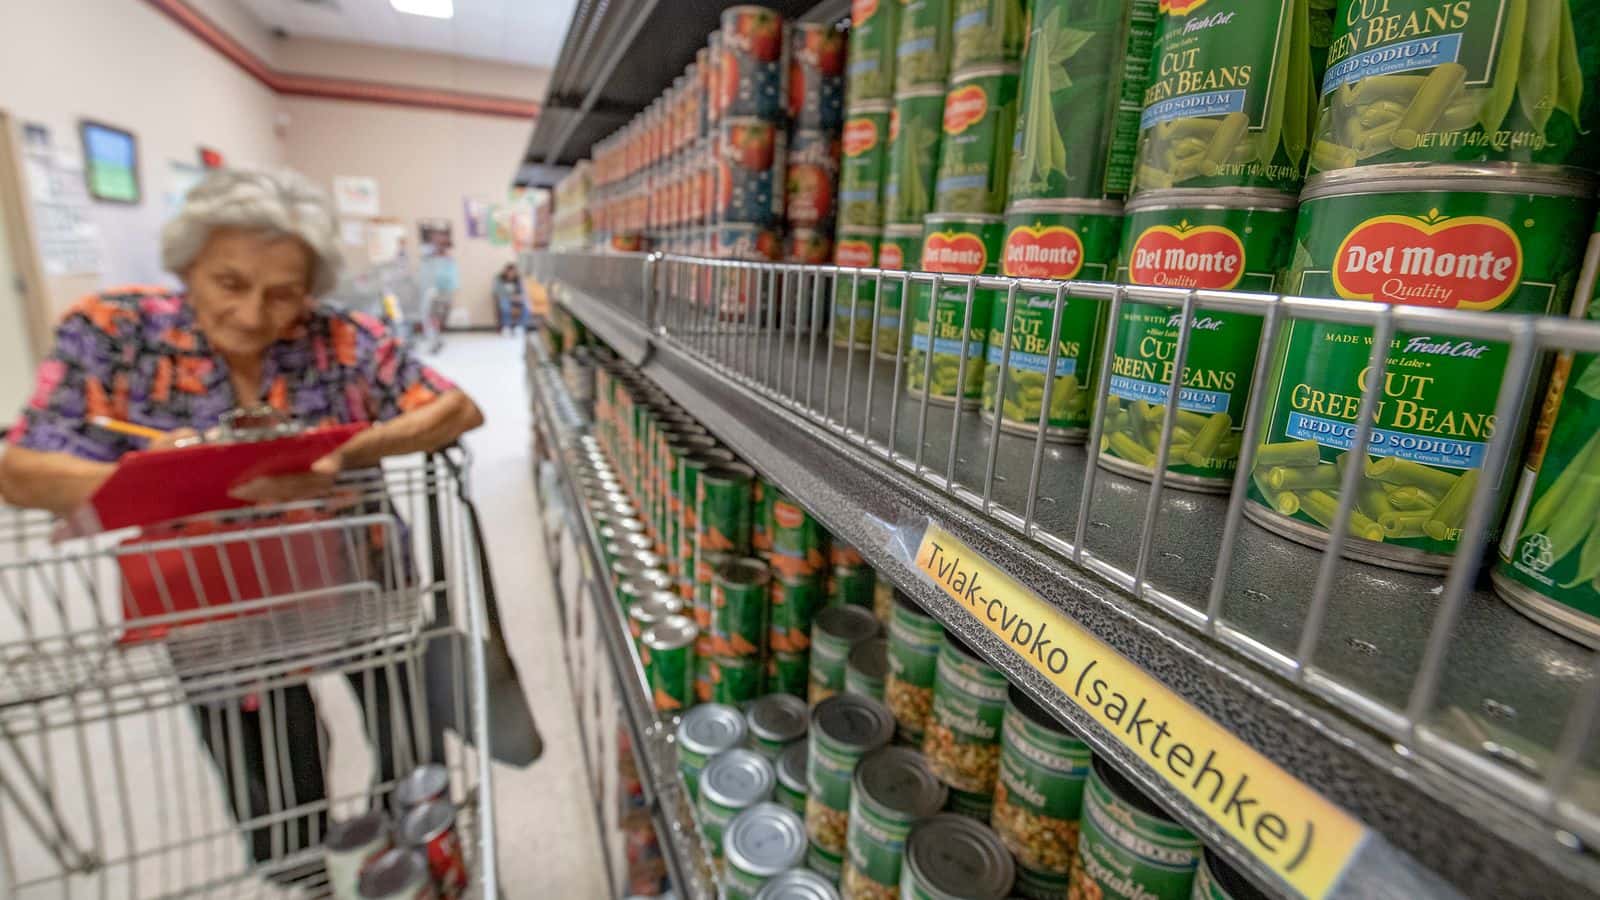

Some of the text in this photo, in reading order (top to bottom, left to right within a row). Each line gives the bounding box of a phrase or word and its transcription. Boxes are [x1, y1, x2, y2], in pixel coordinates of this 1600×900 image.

[1364, 1, 1470, 48] BEANS
[1161, 48, 1200, 76] CUT
[1362, 40, 1440, 66] SODIUM
[1176, 65, 1252, 95] BEANS
[1175, 94, 1230, 108] SODIUM
[1415, 133, 1439, 147] NET
[1439, 132, 1461, 147] WT
[1025, 244, 1077, 265] Monte
[1136, 247, 1238, 274] Del Monte
[1345, 246, 1512, 281] Del Monte
[1153, 271, 1198, 288] Quality
[1382, 278, 1452, 304] Quality
[1024, 334, 1080, 357] BENS
[1324, 333, 1359, 344] MADE
[1364, 336, 1401, 348] WH
[1399, 358, 1425, 369] Lake
[1291, 383, 1499, 439] GREEN BEANS
[1299, 416, 1473, 458] REDUCD SODIUM
[927, 541, 1315, 873] Tvlak-cvpko (saktehke)
